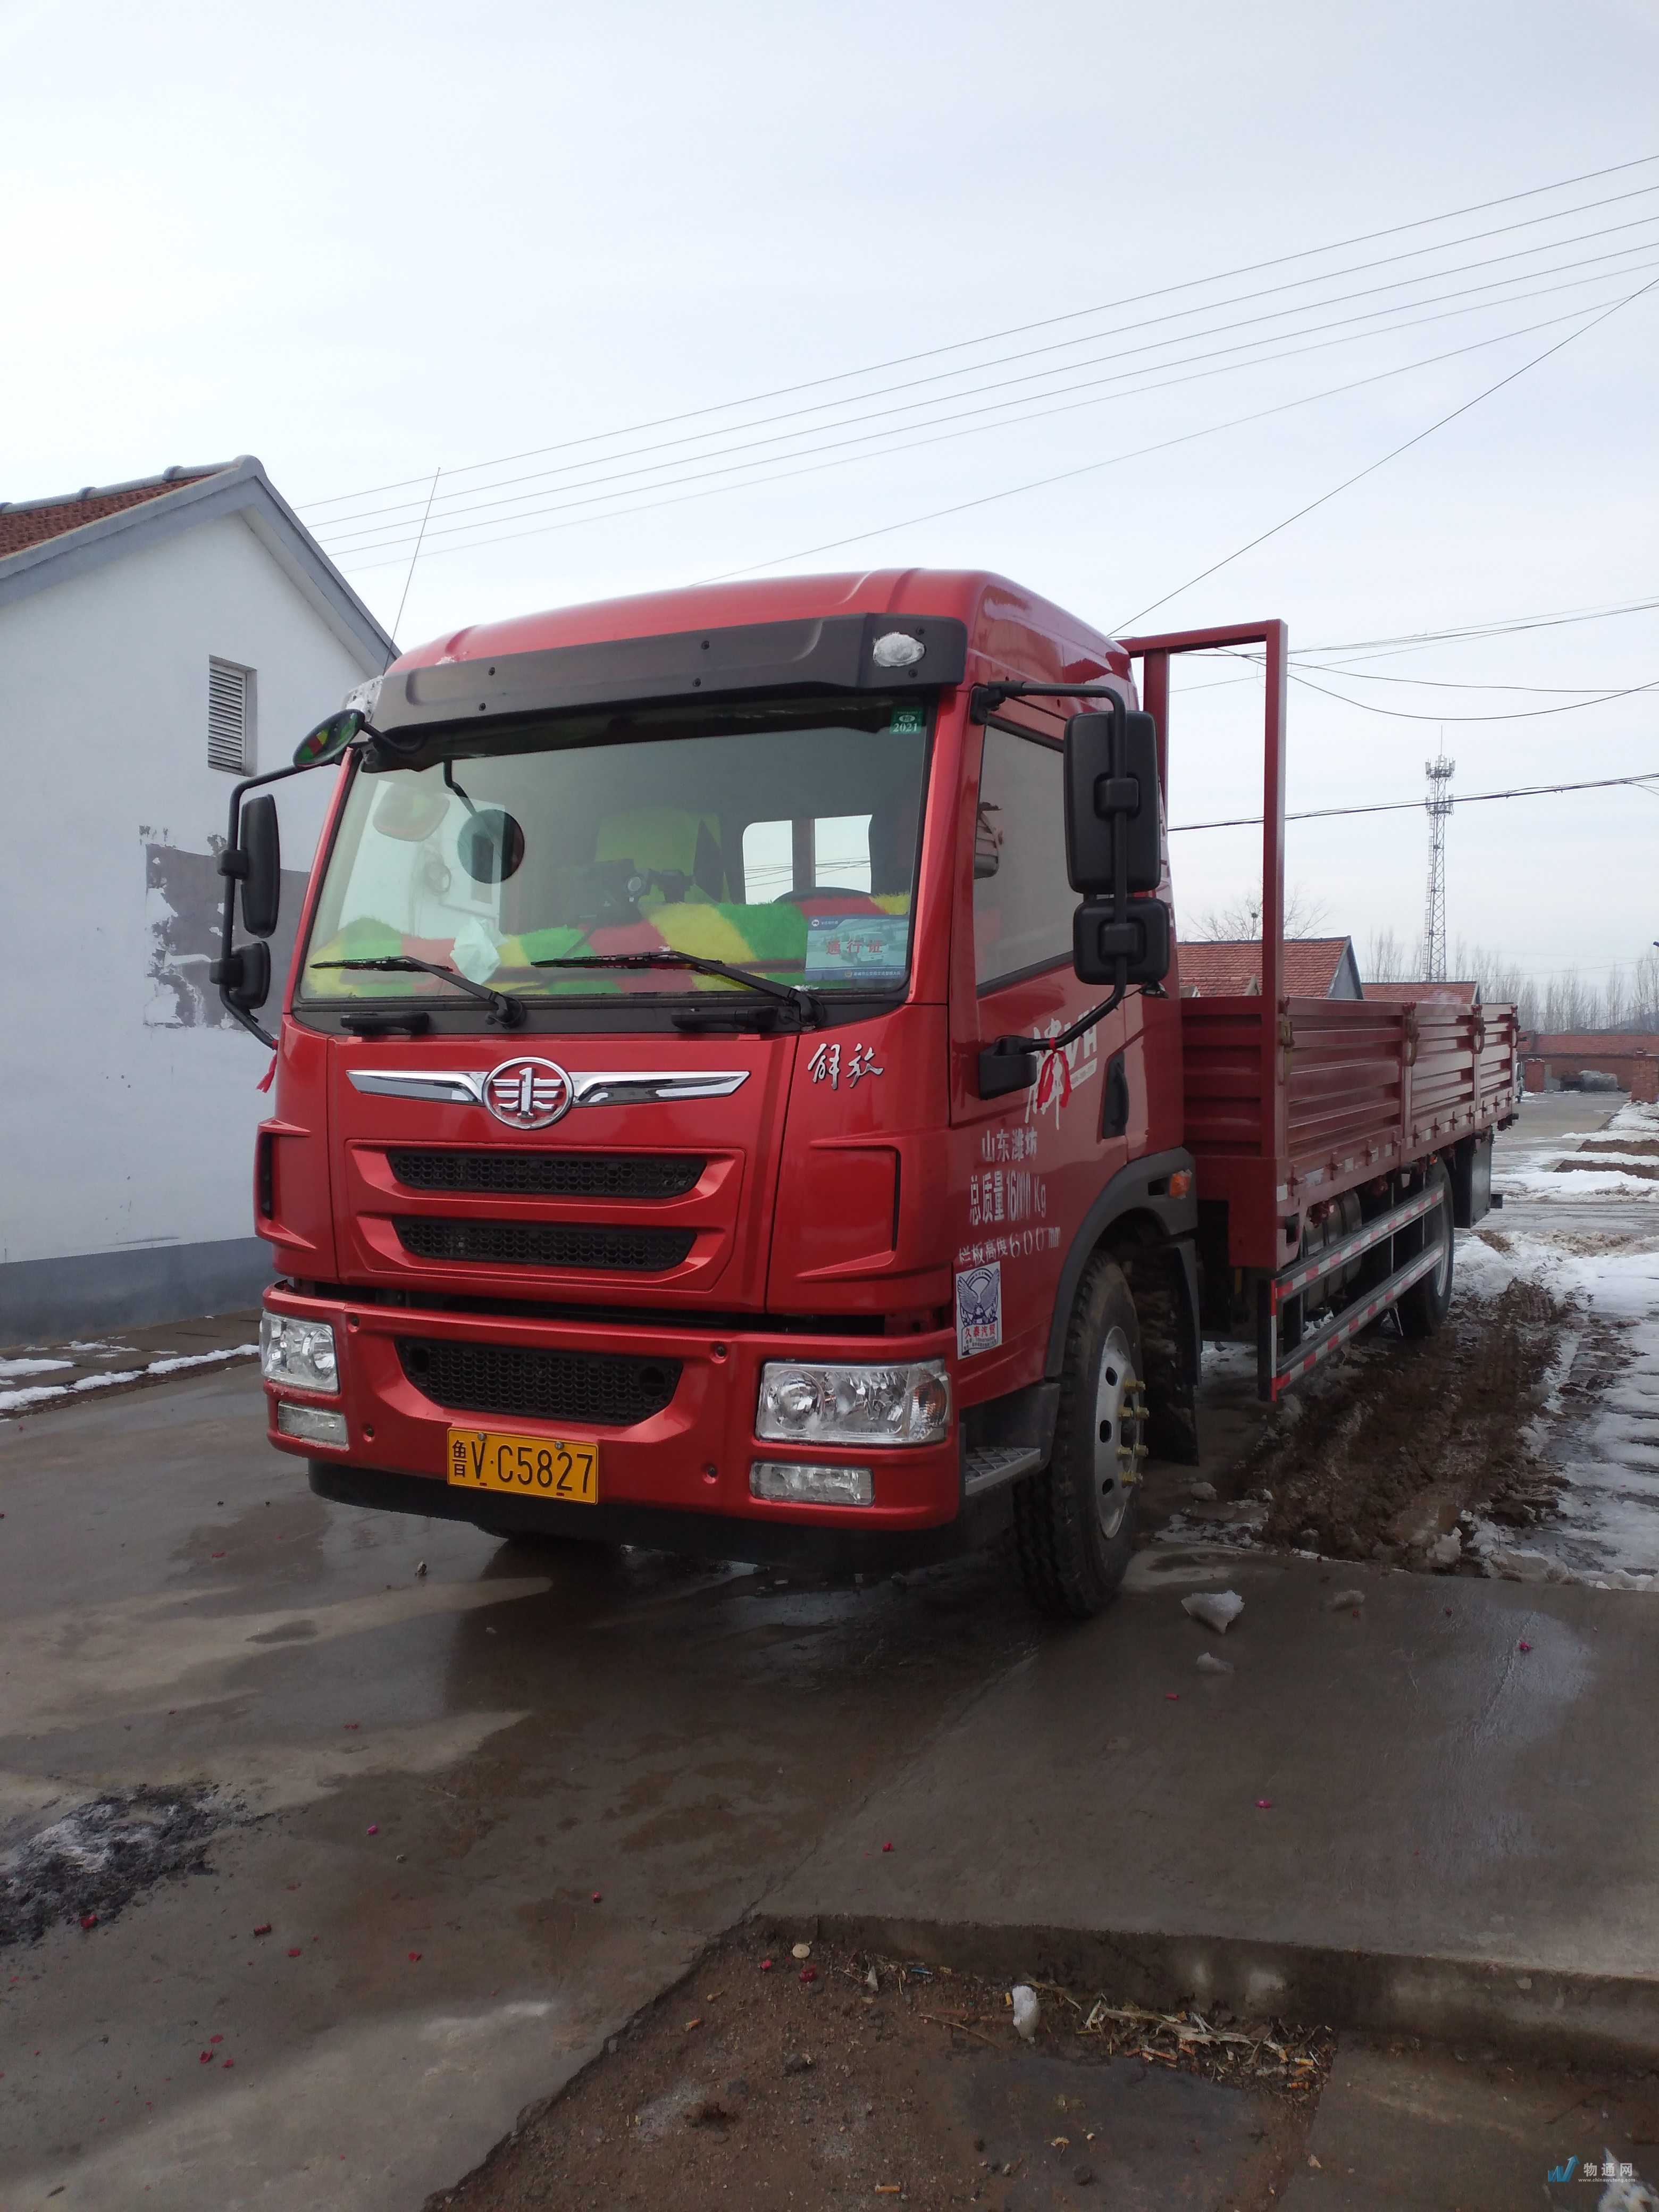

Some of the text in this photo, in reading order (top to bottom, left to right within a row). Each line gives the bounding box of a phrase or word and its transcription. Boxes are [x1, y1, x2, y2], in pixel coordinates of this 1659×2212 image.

[893, 723, 917, 732] 2021
[826, 940, 883, 954] 通行证
[982, 1127, 1037, 1161] 山东潍坊
